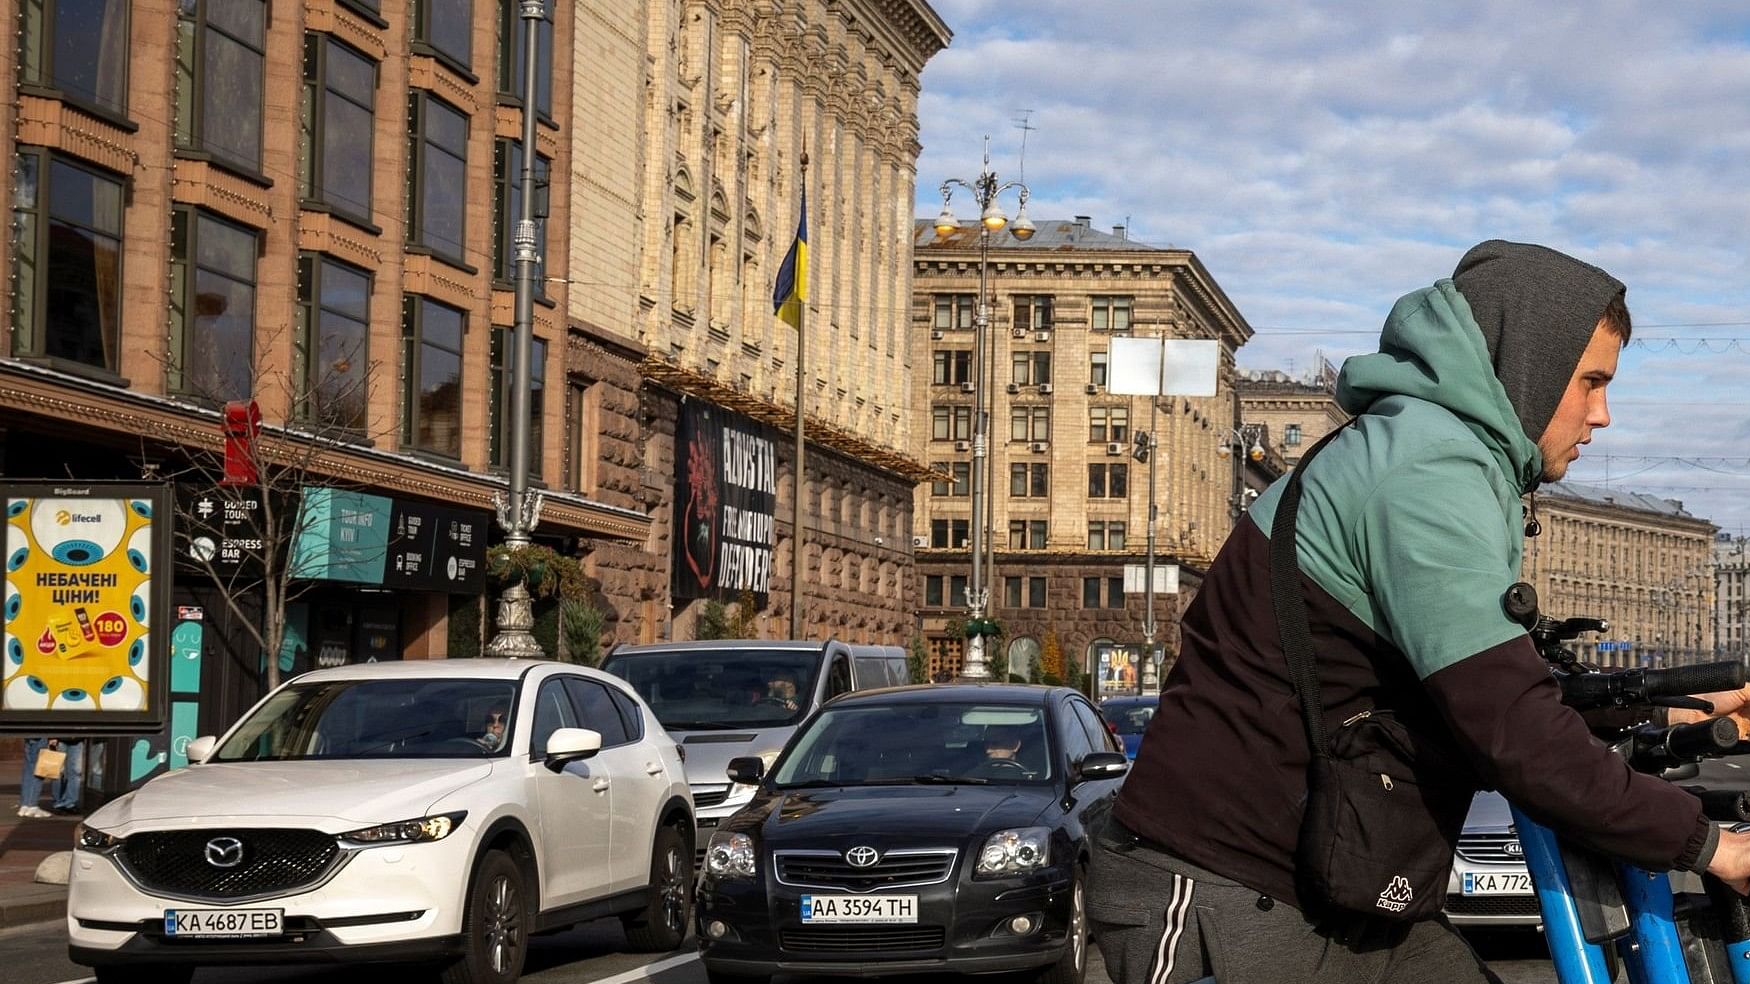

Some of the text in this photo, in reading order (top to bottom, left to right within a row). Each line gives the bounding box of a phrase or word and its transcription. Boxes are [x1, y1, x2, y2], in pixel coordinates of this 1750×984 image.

[72, 514, 101, 523] lifecell
[222, 549, 240, 558] BAR
[36, 573, 117, 587] НЕБАЧЕНІ
[52, 590, 100, 606] ЦІНИ!
[97, 620, 124, 633] 180
[1474, 875, 1533, 891] KA 772
[813, 899, 911, 916] AA 3594 TH
[1376, 898, 1408, 912] Kapp
[176, 913, 278, 931] KA 4687 EB
